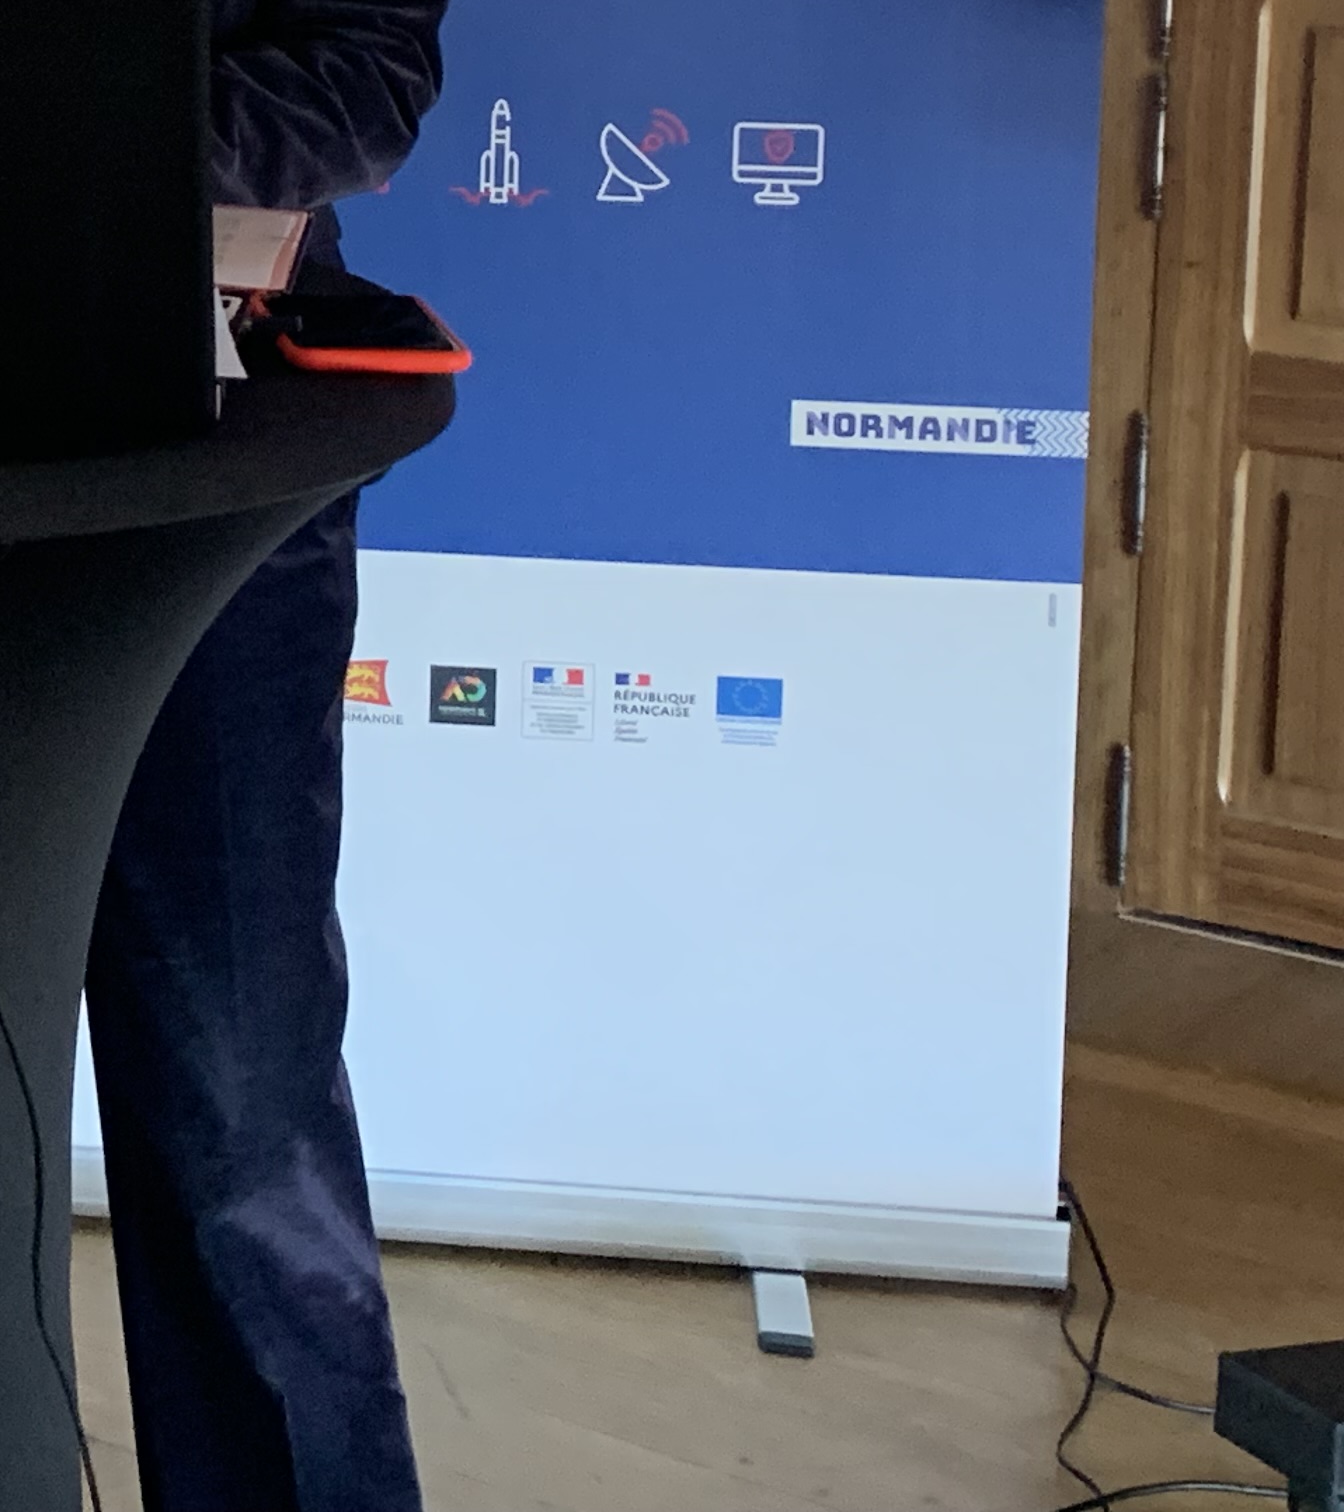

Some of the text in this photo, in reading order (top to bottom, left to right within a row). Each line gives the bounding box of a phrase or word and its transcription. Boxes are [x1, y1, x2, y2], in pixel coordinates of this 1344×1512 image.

[805, 410, 1037, 446] NORMANDIE
[614, 689, 697, 705] RÉPUBLIQUE
[613, 703, 690, 718] FRANÇAISE
